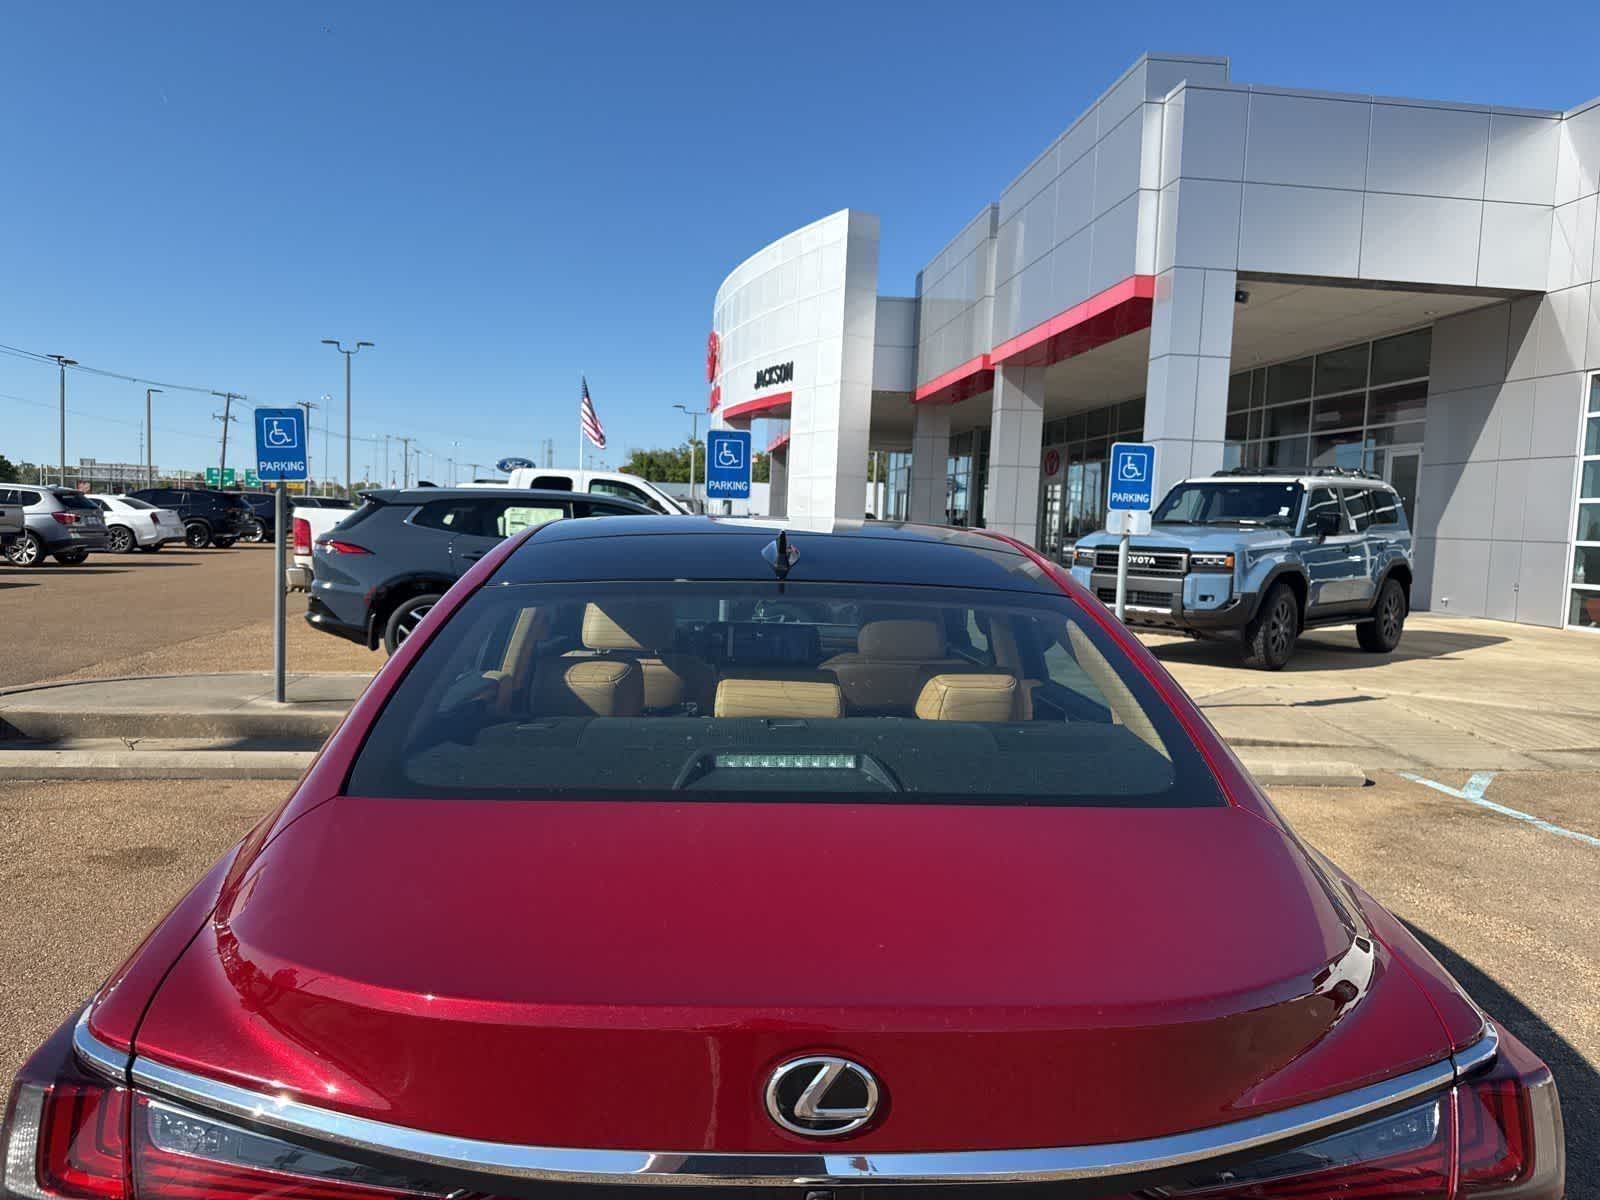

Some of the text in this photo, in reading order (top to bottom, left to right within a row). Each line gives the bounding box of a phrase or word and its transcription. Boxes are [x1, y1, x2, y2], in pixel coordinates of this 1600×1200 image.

[753, 360, 794, 390] JACKSON
[259, 461, 305, 471] PARKING
[708, 480, 748, 491] PARKING
[1111, 492, 1149, 503] PARKING
